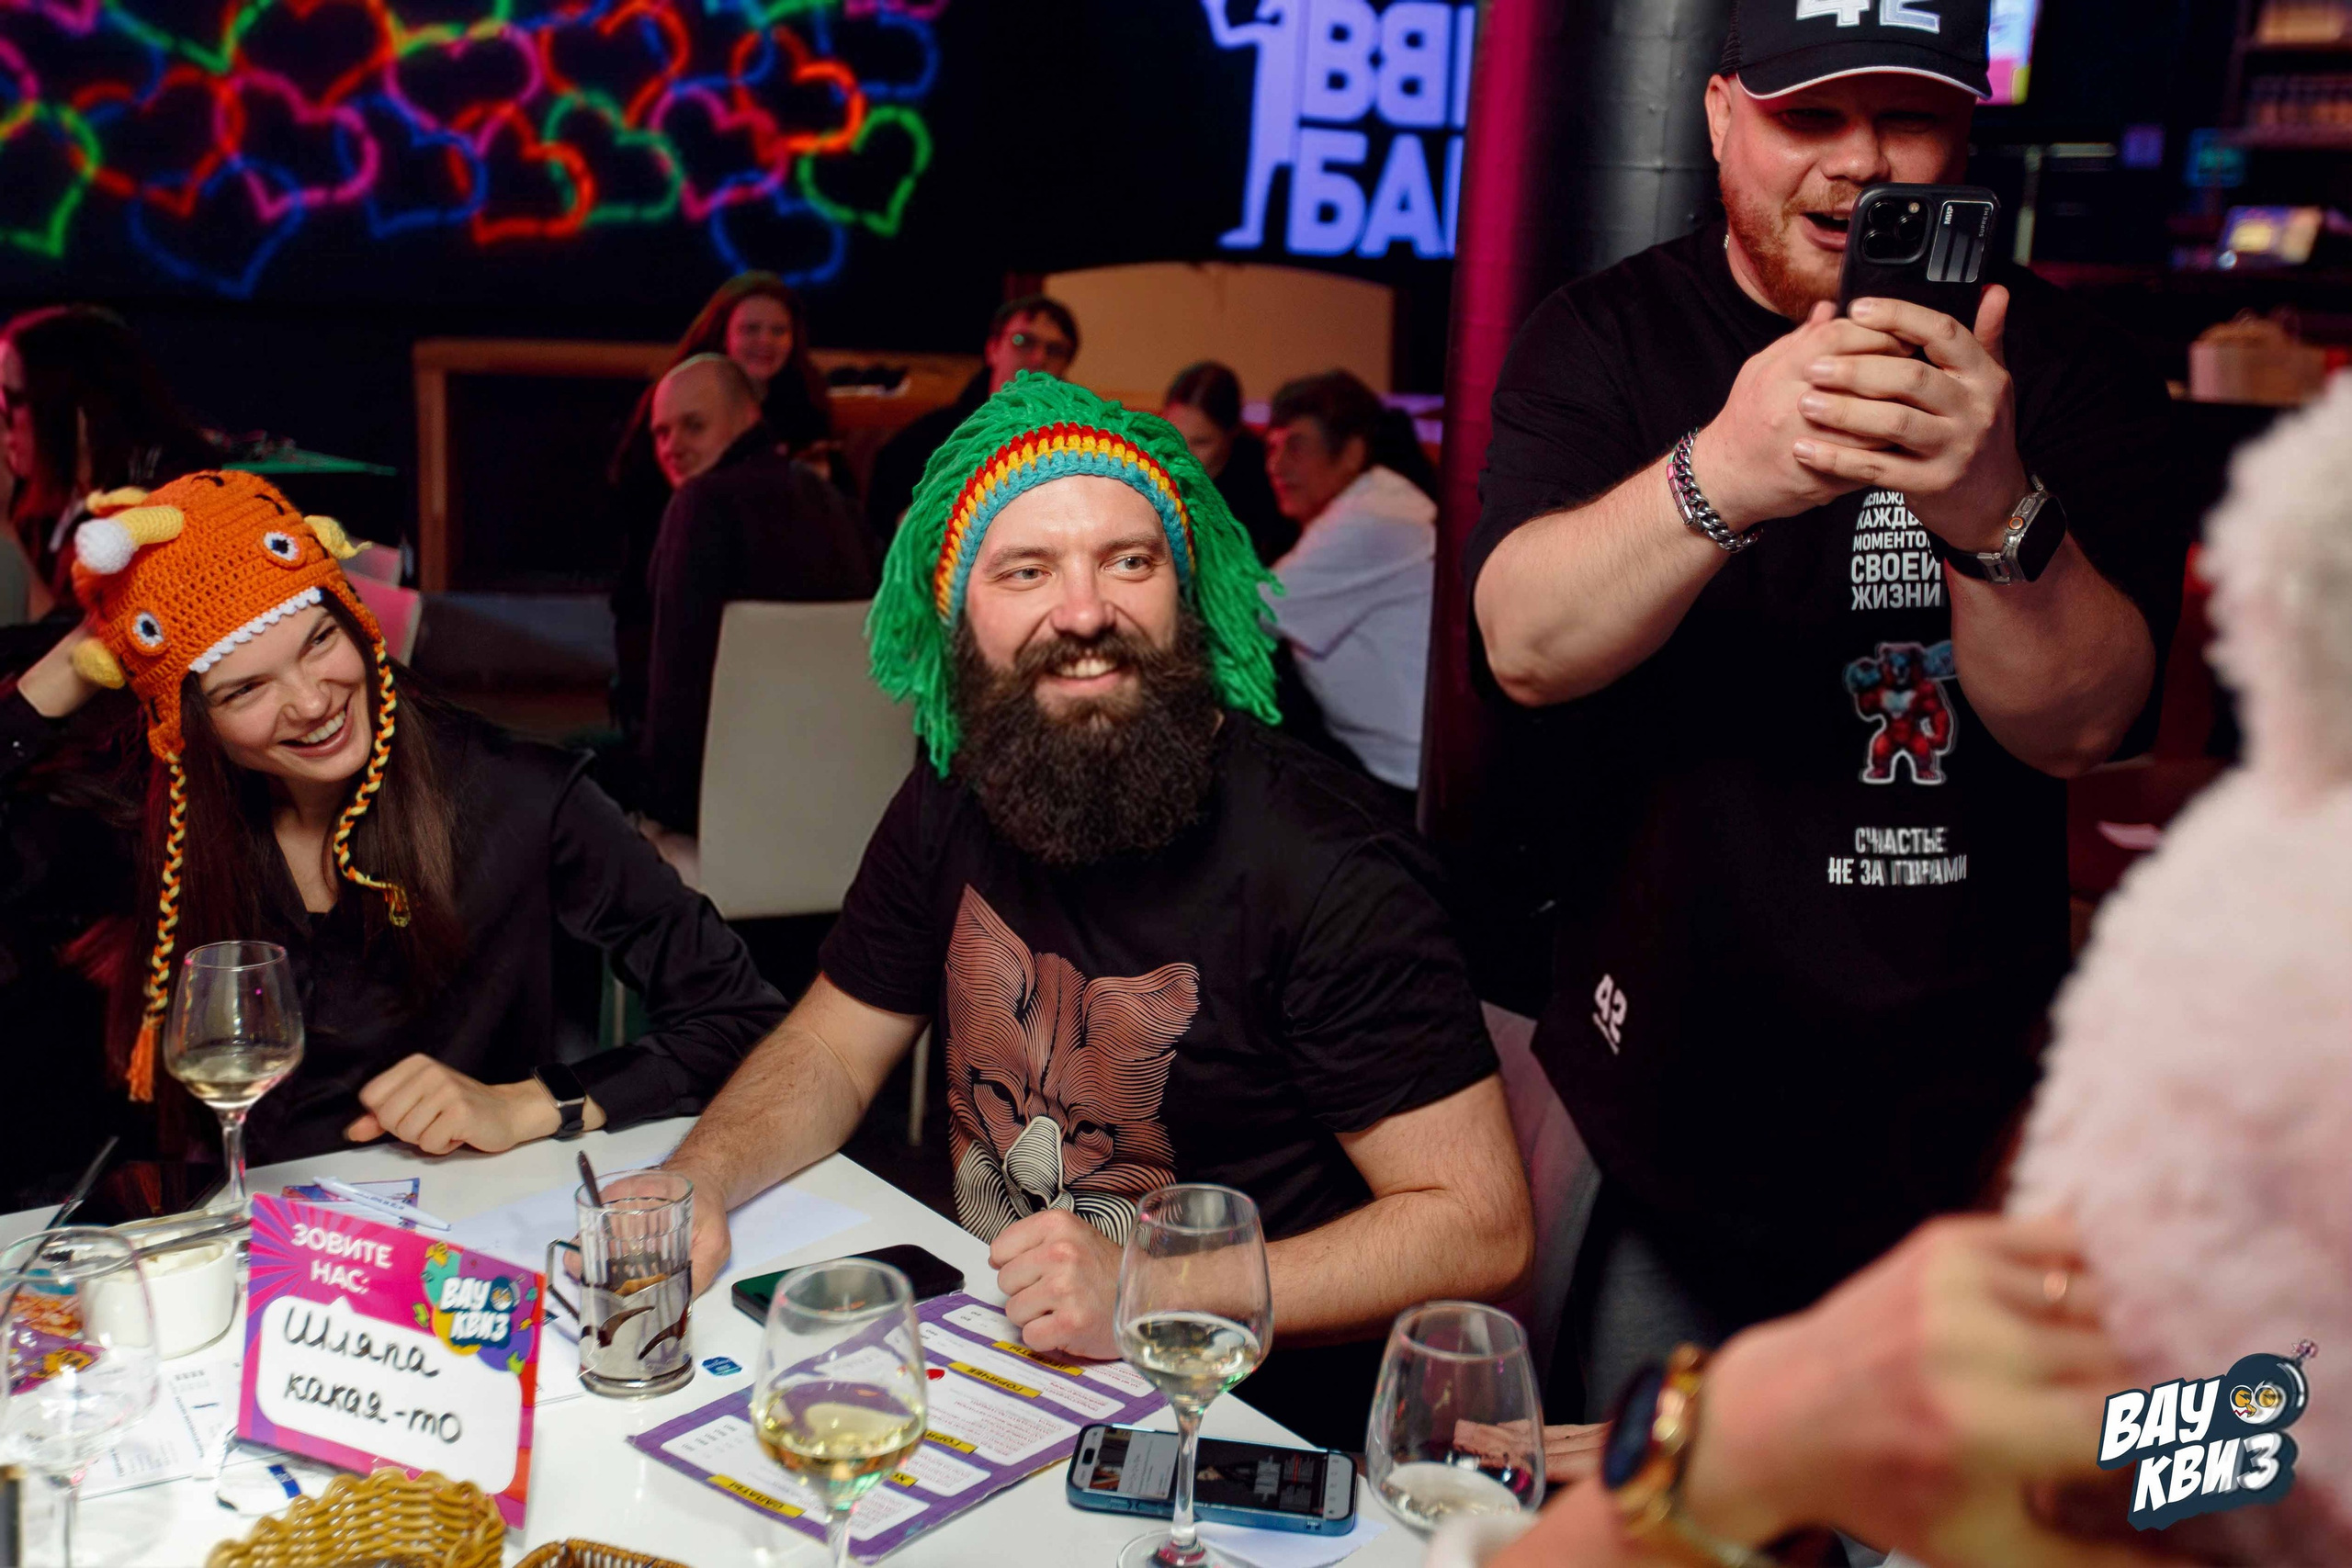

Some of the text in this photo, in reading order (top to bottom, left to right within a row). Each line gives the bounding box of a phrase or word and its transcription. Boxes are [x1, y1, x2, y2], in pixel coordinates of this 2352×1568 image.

[1978, 207, 1990, 238] SUPREME
[1852, 530, 1931, 552] МОМЕНТО
[1851, 582, 1941, 611] ЖИЗНИ
[1855, 827, 1947, 855] СЧАСТЬЕ
[1827, 856, 1855, 885] НЕ
[1860, 859, 1885, 886] ЗА
[290, 1224, 393, 1269] ЗОВИТЕ
[311, 1260, 370, 1295] НАС:
[440, 1277, 492, 1313] ВАУ
[283, 1306, 440, 1378] Шляпа
[449, 1310, 511, 1343] КВИЗ
[968, 1366, 1024, 1393] ГОРЯЧЕЕ
[283, 1372, 463, 1445] какая-то
[729, 1482, 783, 1510] САЛАТЫ
